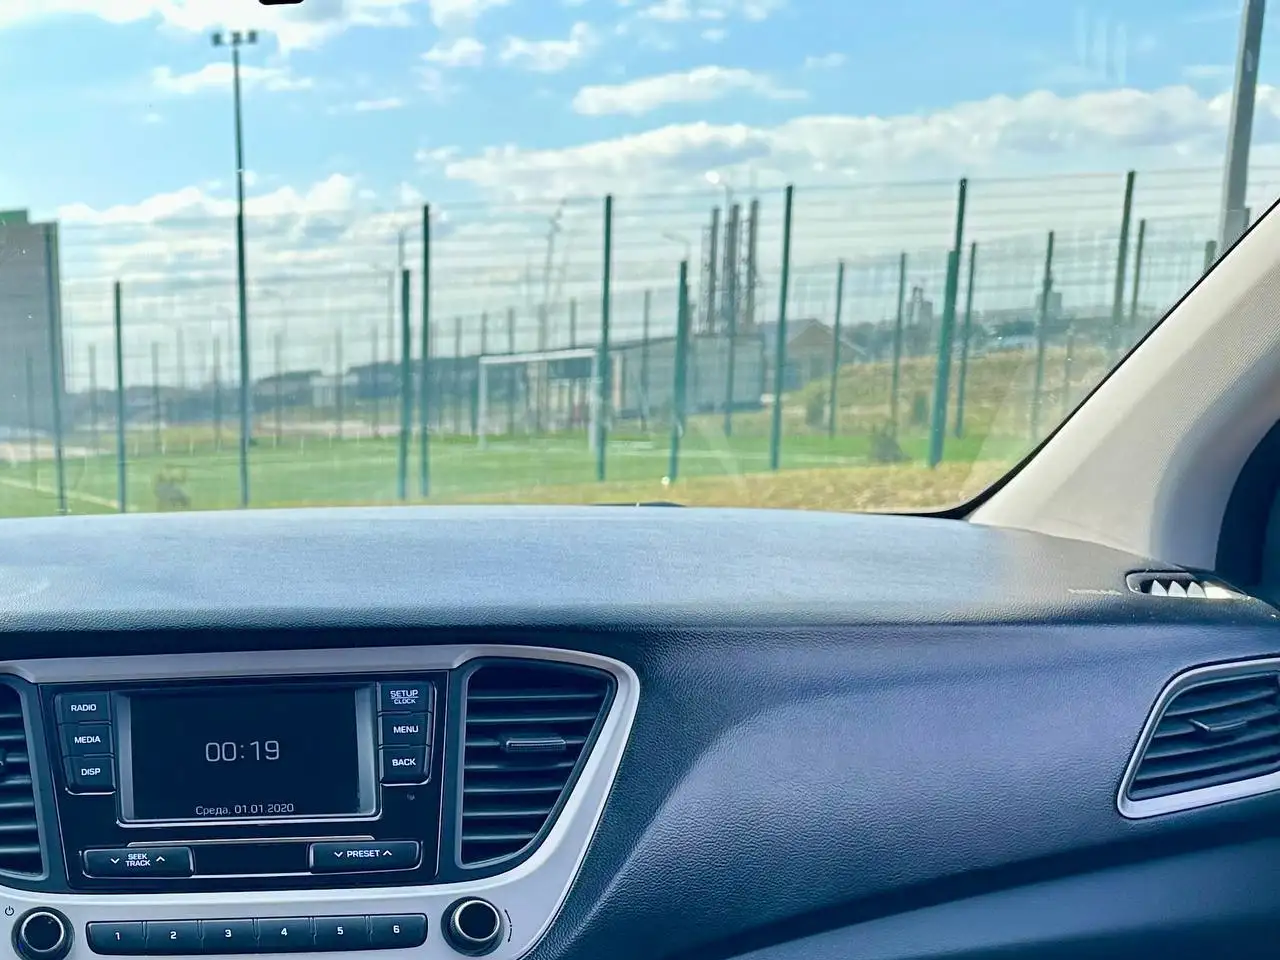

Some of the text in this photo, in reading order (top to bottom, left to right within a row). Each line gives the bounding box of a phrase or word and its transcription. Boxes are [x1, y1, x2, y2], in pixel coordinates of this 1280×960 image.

[390, 689, 419, 698] SETUP
[70, 703, 97, 712] RADIO
[393, 725, 419, 734] MENU
[74, 735, 101, 744] MEDIA
[205, 740, 280, 762] 00:19
[392, 758, 417, 767] BACK
[81, 767, 101, 776] DISP
[234, 803, 295, 814] 01.01.2020
[346, 849, 380, 859] PRESET
[125, 859, 151, 868] TRACK
[224, 929, 232, 938] 3
[280, 927, 288, 937] 4
[337, 926, 344, 936] 5
[393, 924, 401, 934] 6
[115, 931, 121, 941] 1
[170, 930, 177, 940] 2
